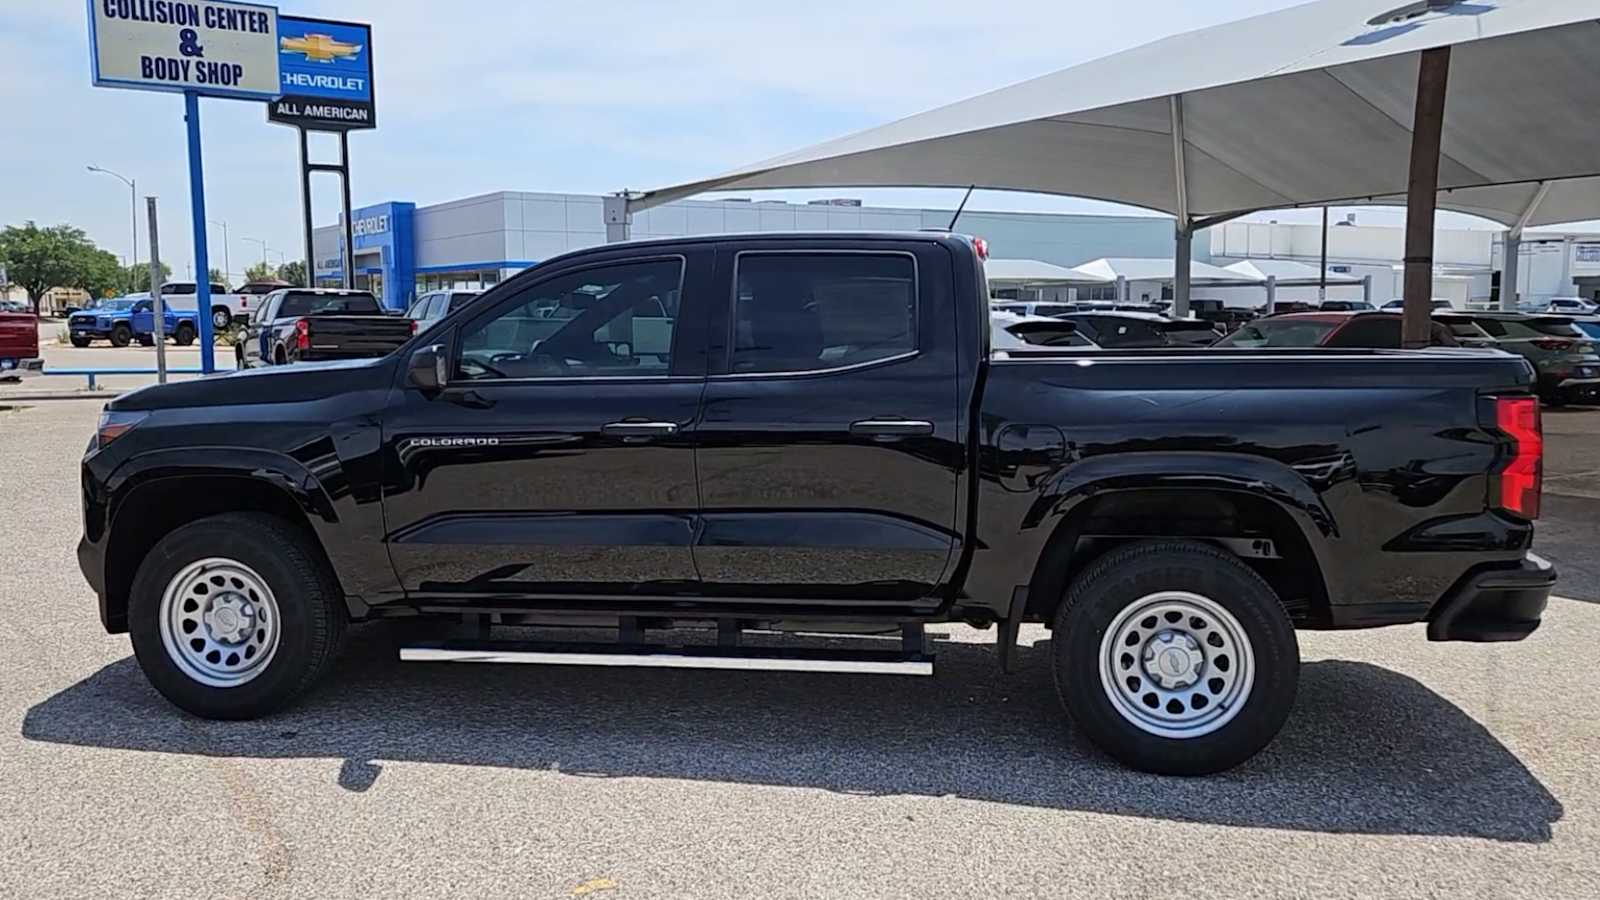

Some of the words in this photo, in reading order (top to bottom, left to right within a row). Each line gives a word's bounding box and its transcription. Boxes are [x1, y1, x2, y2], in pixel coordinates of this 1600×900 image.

[103, 0, 200, 27] COLLISION
[204, 6, 270, 34] CENTER
[179, 28, 204, 57] &
[141, 56, 190, 82] BODY
[195, 61, 243, 86] SHOP
[277, 103, 301, 115] ALL
[304, 105, 368, 120] AMERICAN
[410, 438, 500, 446] COLORADO
